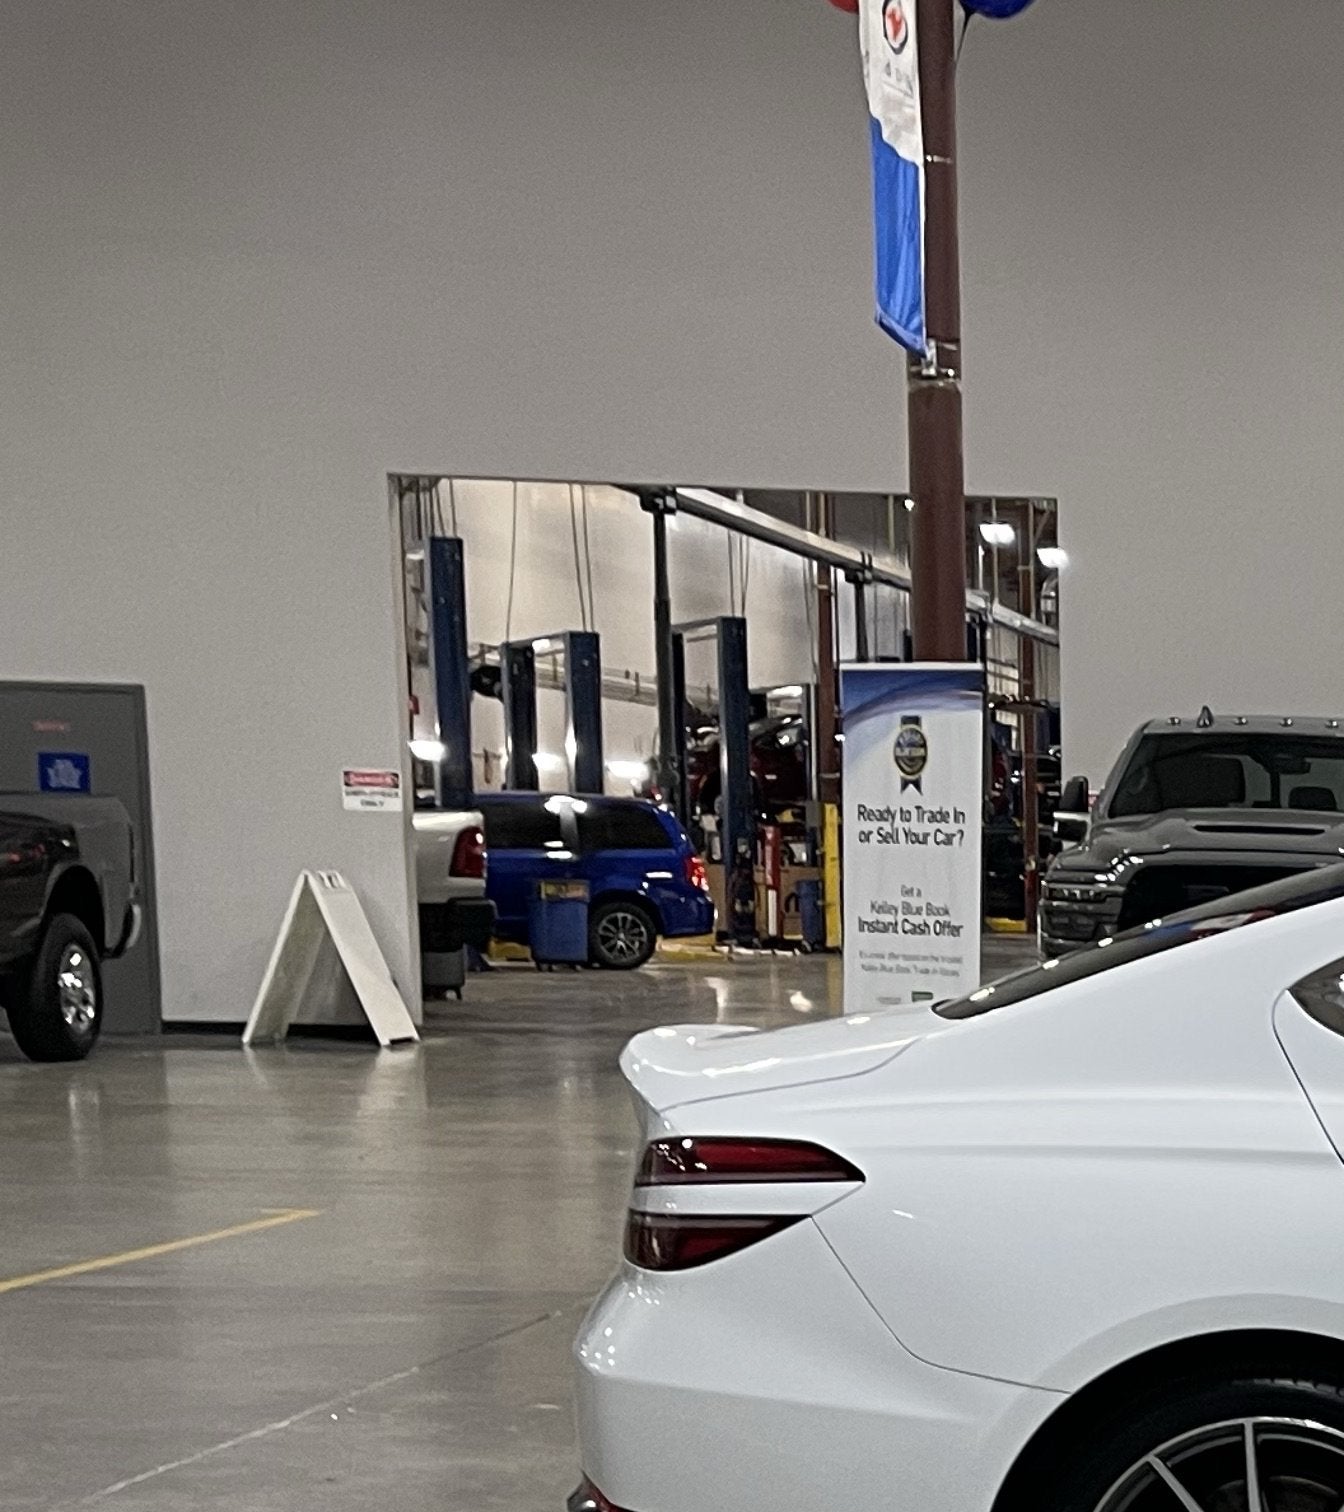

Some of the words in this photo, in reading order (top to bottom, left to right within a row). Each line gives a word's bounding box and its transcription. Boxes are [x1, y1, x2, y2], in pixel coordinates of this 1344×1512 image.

[857, 803, 897, 828] Ready
[900, 806, 912, 823] to
[914, 805, 950, 824] Trade
[954, 806, 966, 824] In
[858, 829, 873, 844] or
[877, 826, 900, 844] Sell
[902, 827, 931, 845] Your
[934, 828, 965, 847] Car?
[870, 900, 899, 919] Kelley
[901, 900, 924, 916] Blue
[926, 901, 950, 917] Book
[858, 916, 899, 934] Instant
[901, 918, 931, 936] Cash
[933, 920, 964, 937] Offer
